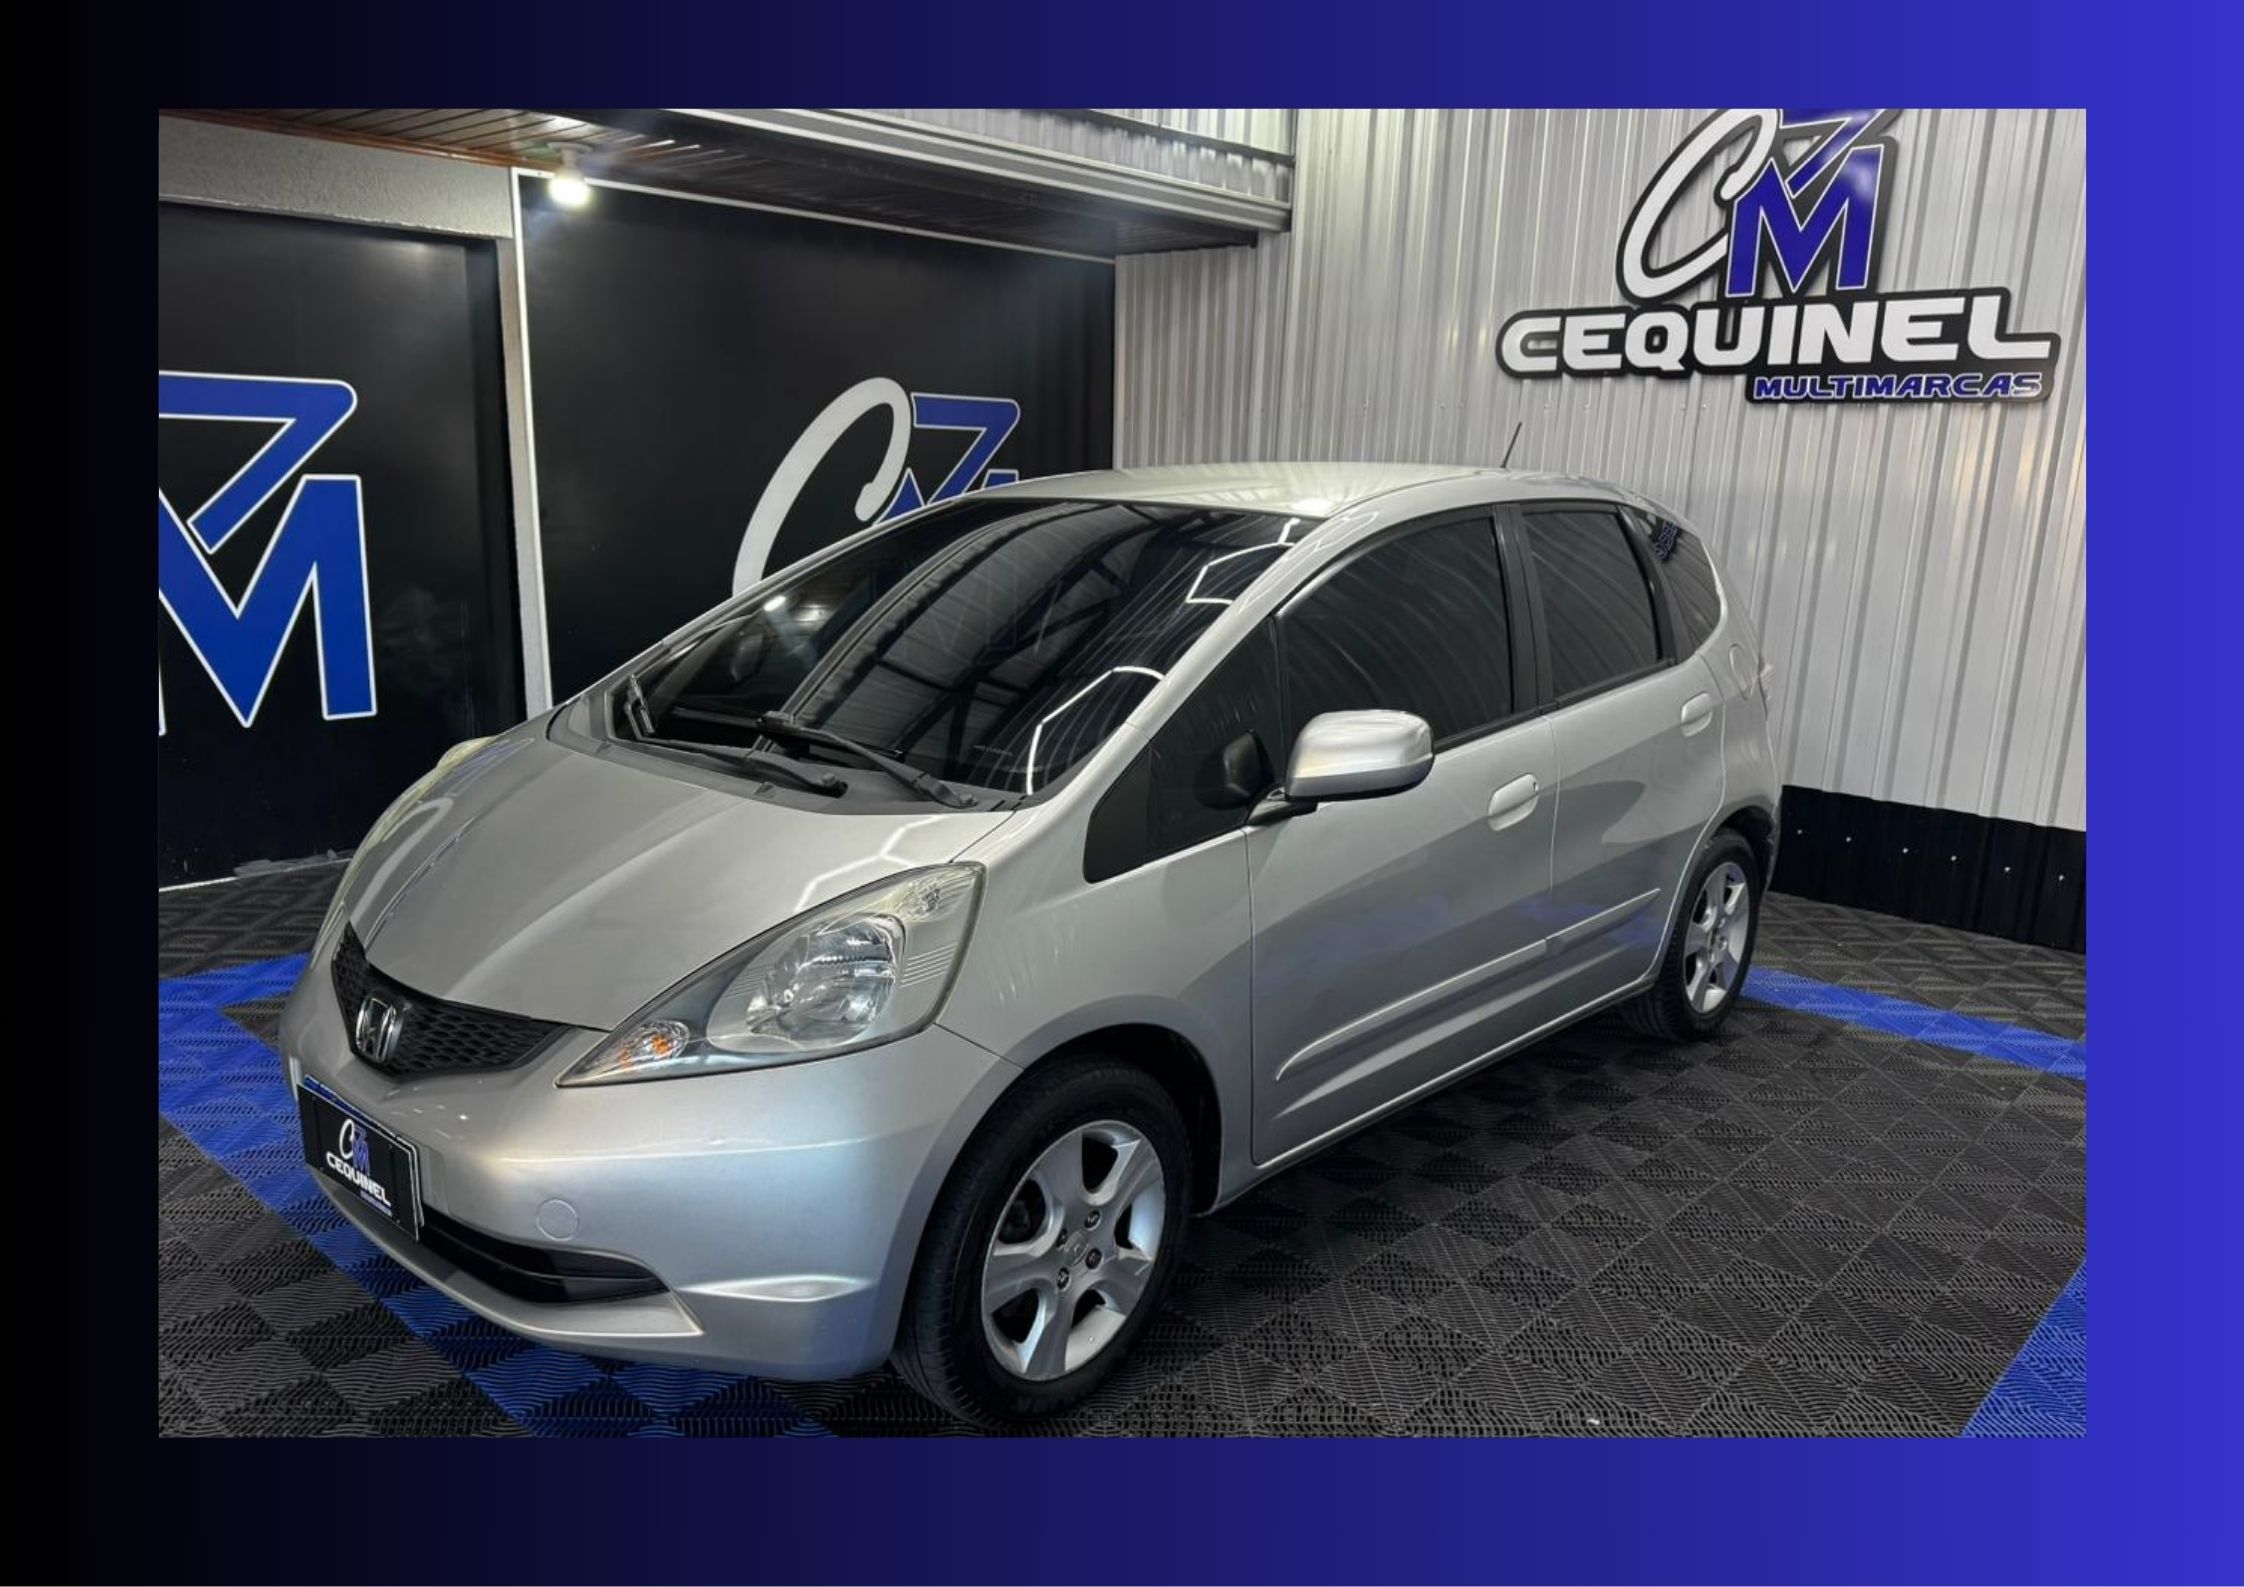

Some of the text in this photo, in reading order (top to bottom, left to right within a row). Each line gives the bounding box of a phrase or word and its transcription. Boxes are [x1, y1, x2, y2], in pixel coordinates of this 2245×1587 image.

[1501, 295, 2052, 373] CEQUINEL
[1752, 373, 2043, 401] MULTIMARCAS
[325, 1151, 392, 1208] CEQUINEL
